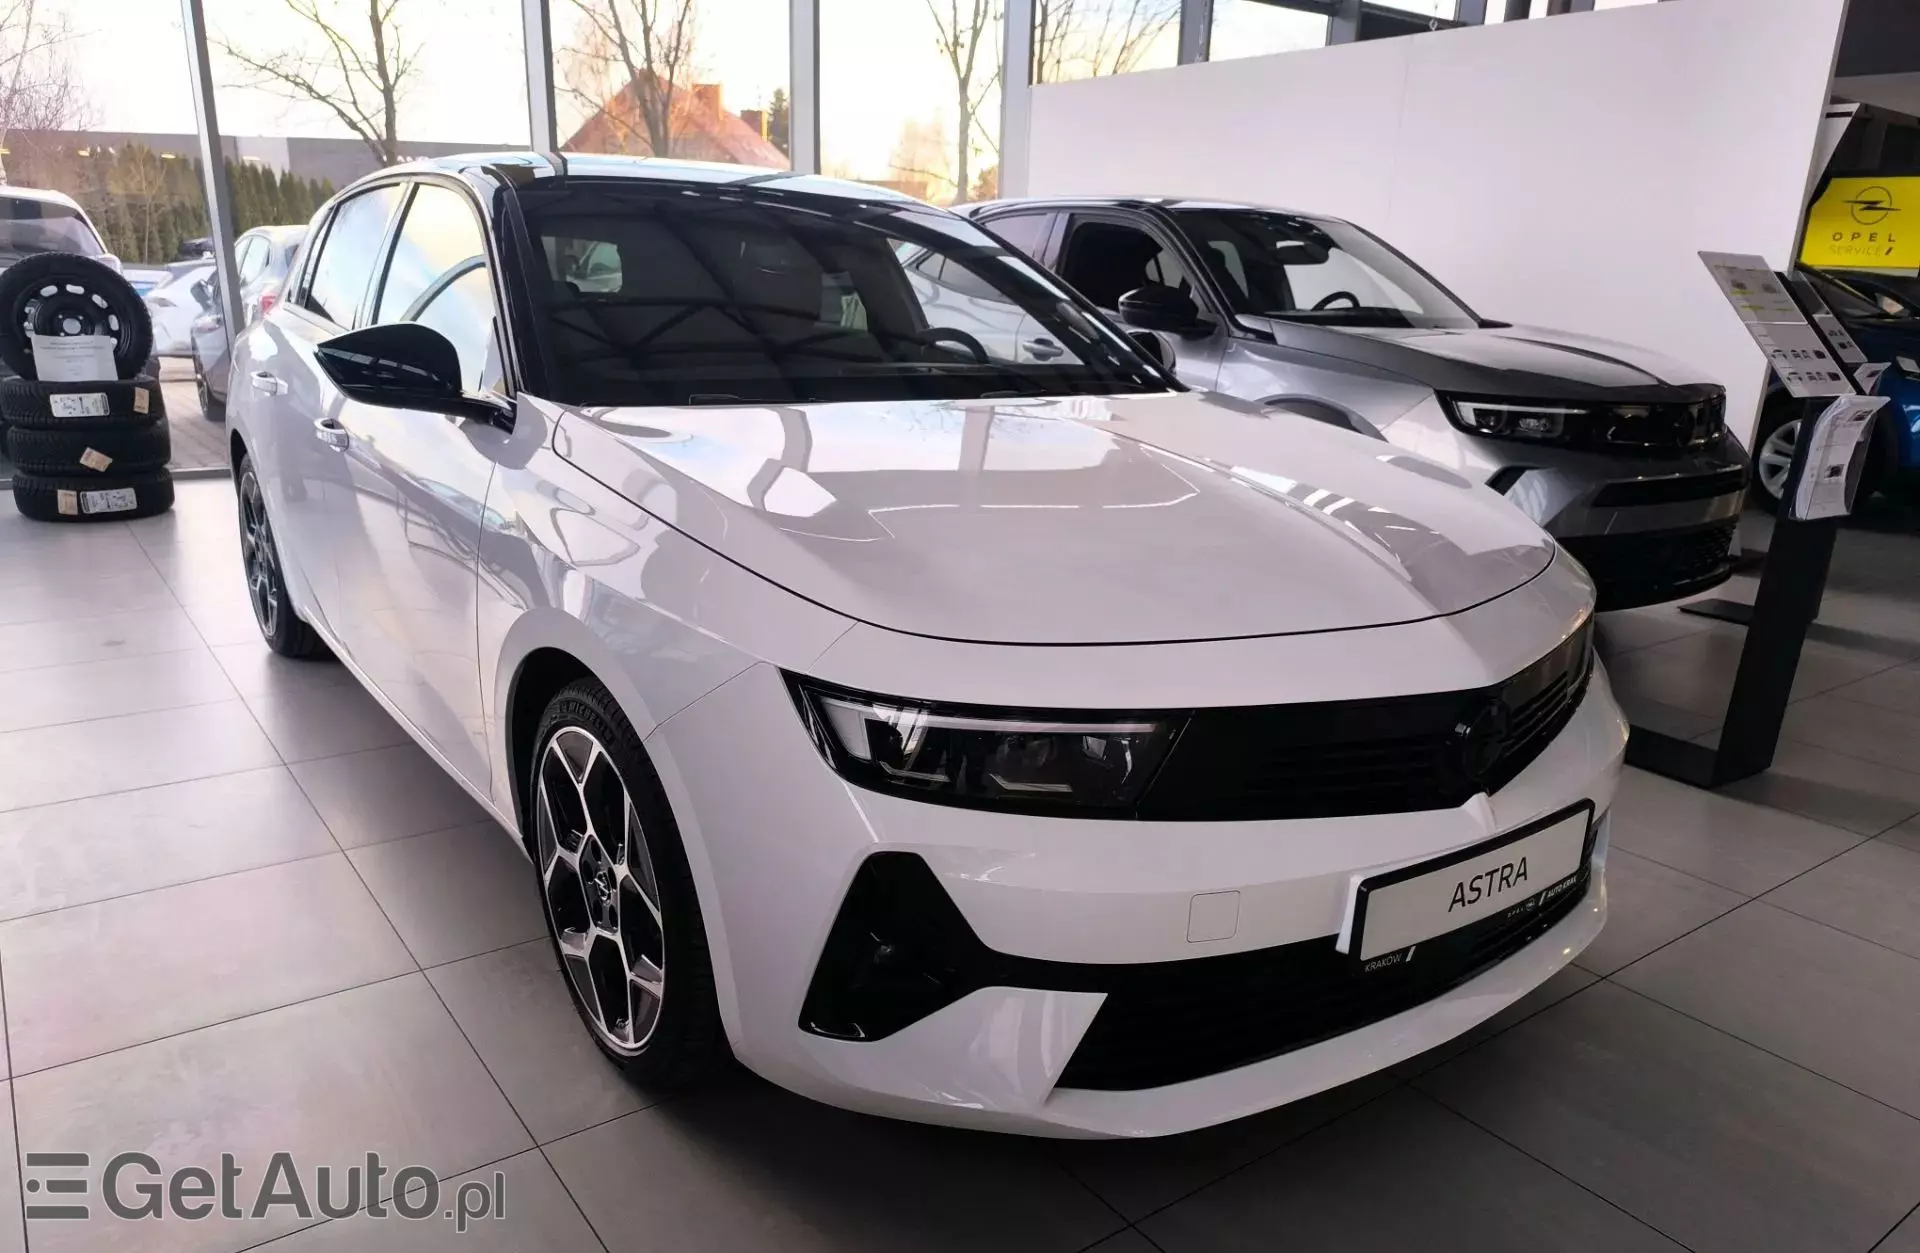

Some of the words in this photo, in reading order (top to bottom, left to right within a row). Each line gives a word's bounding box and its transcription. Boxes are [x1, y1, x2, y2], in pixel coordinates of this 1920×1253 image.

[1832, 231, 1896, 243] OPEL
[1448, 856, 1528, 913] ASTRA
[1364, 953, 1402, 973] KRAKÓW
